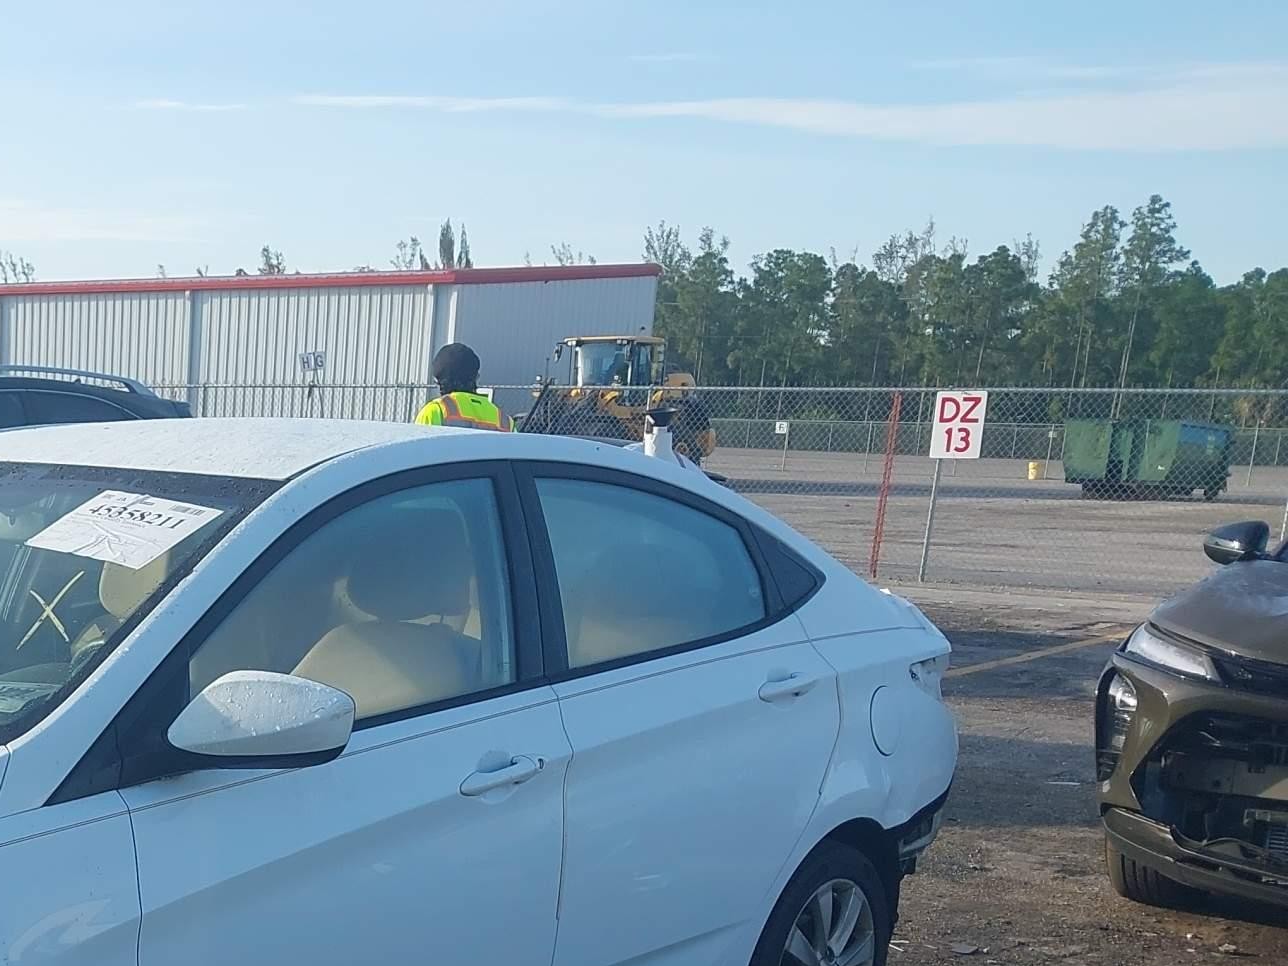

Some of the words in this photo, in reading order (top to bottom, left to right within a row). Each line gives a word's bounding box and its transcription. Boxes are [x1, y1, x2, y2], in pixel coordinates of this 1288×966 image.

[939, 397, 982, 423] DZ
[945, 428, 970, 452] 13
[89, 503, 185, 529] 45358211
